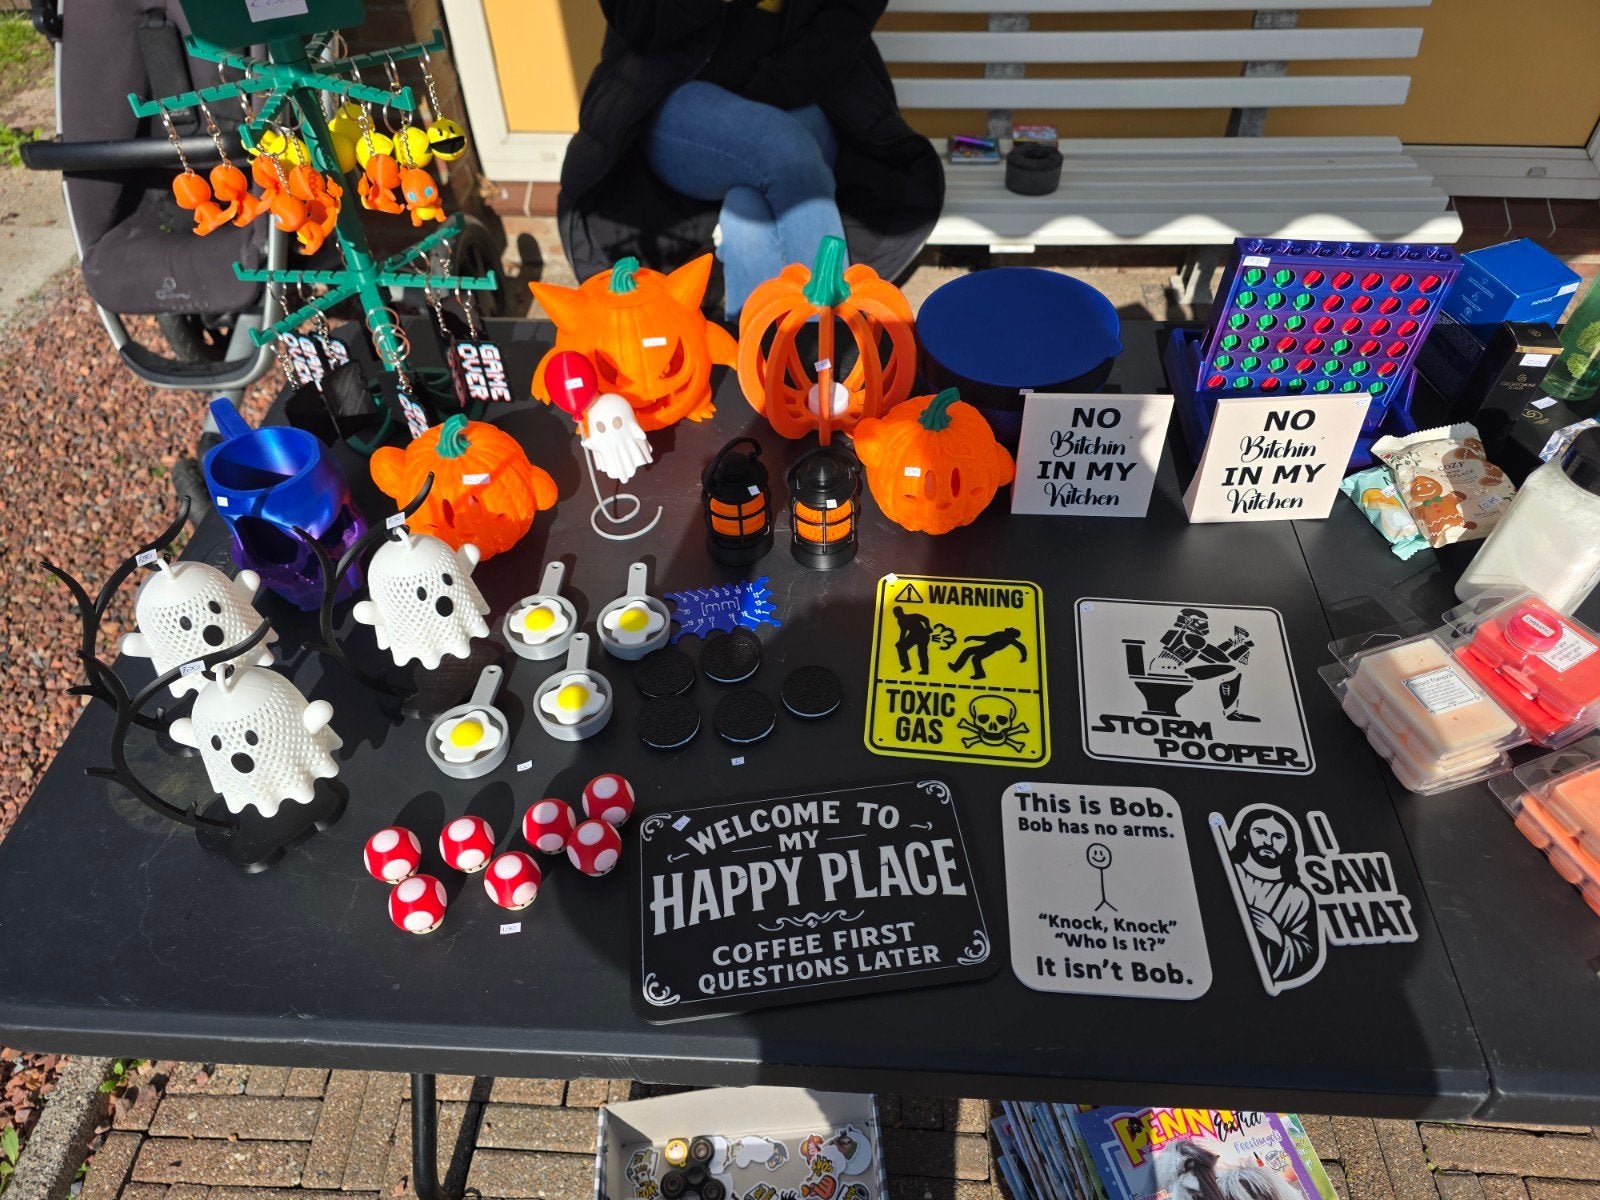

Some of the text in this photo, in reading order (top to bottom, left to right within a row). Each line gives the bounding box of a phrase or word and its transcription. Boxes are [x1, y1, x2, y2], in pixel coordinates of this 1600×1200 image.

[457, 343, 489, 401] OVER
[479, 343, 511, 401] GAME
[1071, 407, 1122, 429] NO
[1263, 409, 1316, 431] NO
[1036, 461, 1138, 482] IN MY
[1221, 463, 1327, 487] IN MY
[1044, 482, 1120, 508] Kitchen
[1226, 488, 1304, 515] Kitchen
[928, 584, 1025, 609] WARNING
[885, 688, 956, 718] TOXIC
[895, 715, 944, 744] GAS
[1091, 713, 1214, 741] STORM
[1153, 738, 1307, 768] POOPER
[1014, 792, 1175, 819] This is Bob.
[686, 800, 900, 856] WELCOME TO
[779, 829, 820, 852] MY
[1018, 817, 1175, 839] Bob has no arms.
[1313, 814, 1336, 851] I
[650, 838, 968, 936] HAPPY PLACE
[1303, 857, 1392, 896] SAW
[1318, 899, 1413, 939] THAT
[711, 921, 916, 967] COFFEE FIRST
[1113, 935, 1128, 951] Is
[698, 944, 941, 995] QUESTIONS LATER
[1036, 955, 1057, 979] It
[1132, 961, 1194, 985] Bob.
